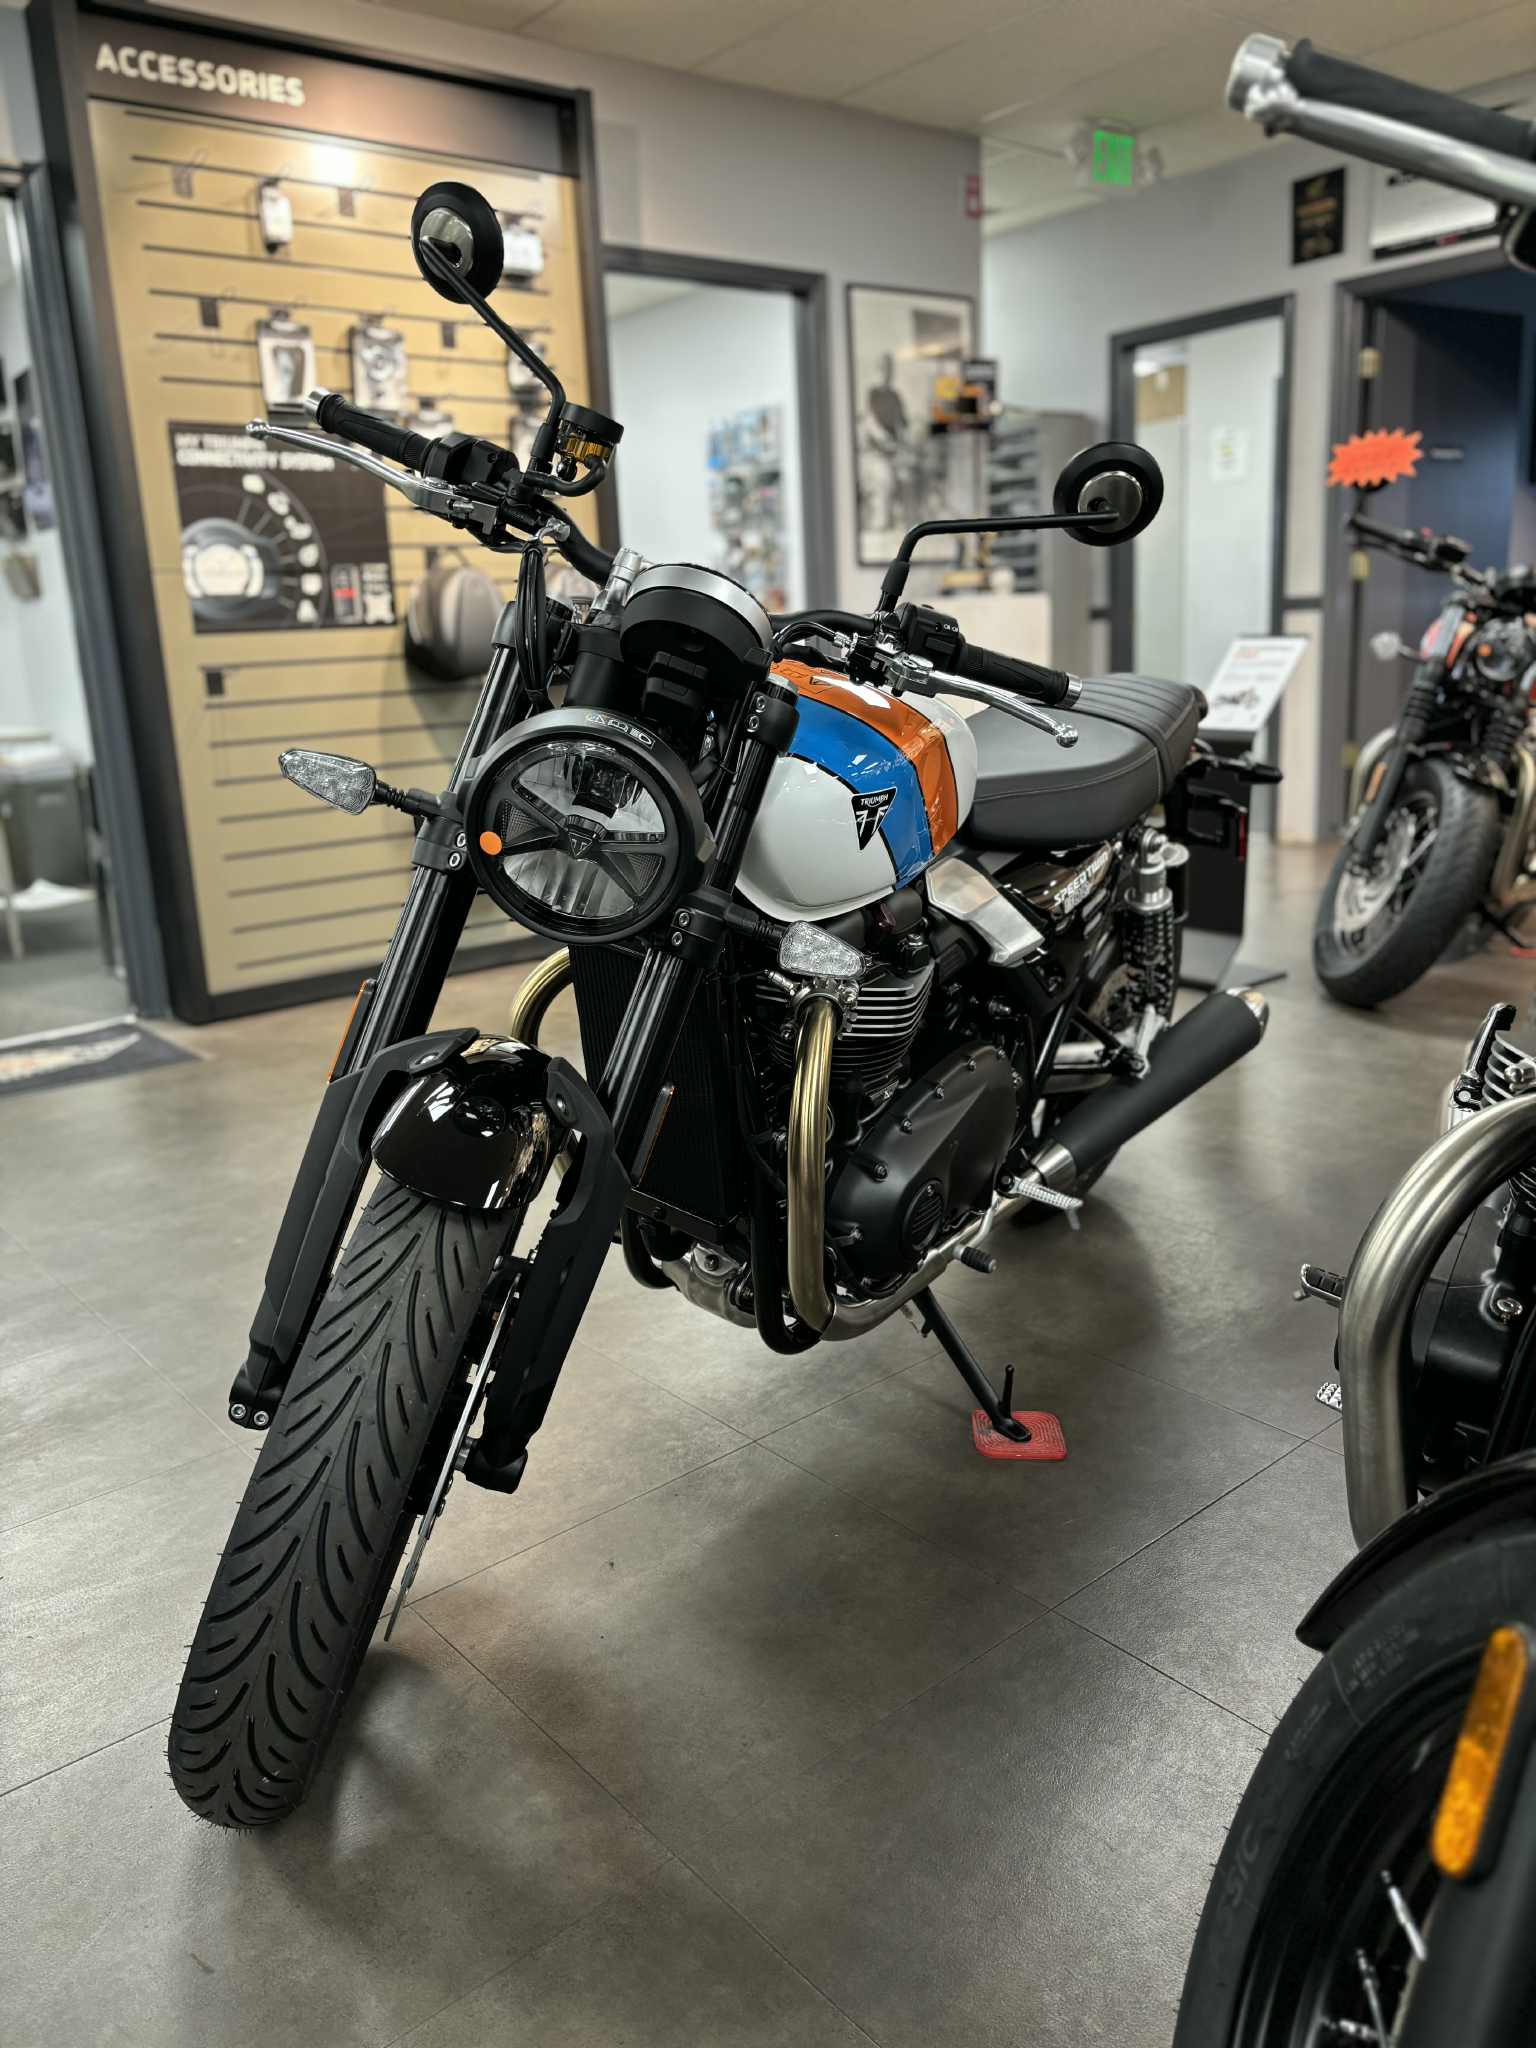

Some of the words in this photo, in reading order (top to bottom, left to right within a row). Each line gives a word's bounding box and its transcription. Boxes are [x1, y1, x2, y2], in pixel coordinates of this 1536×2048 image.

[96, 43, 305, 107] ACCESSORIES
[860, 793, 889, 807] TRIUMPH
[1053, 871, 1087, 907] SPEED
